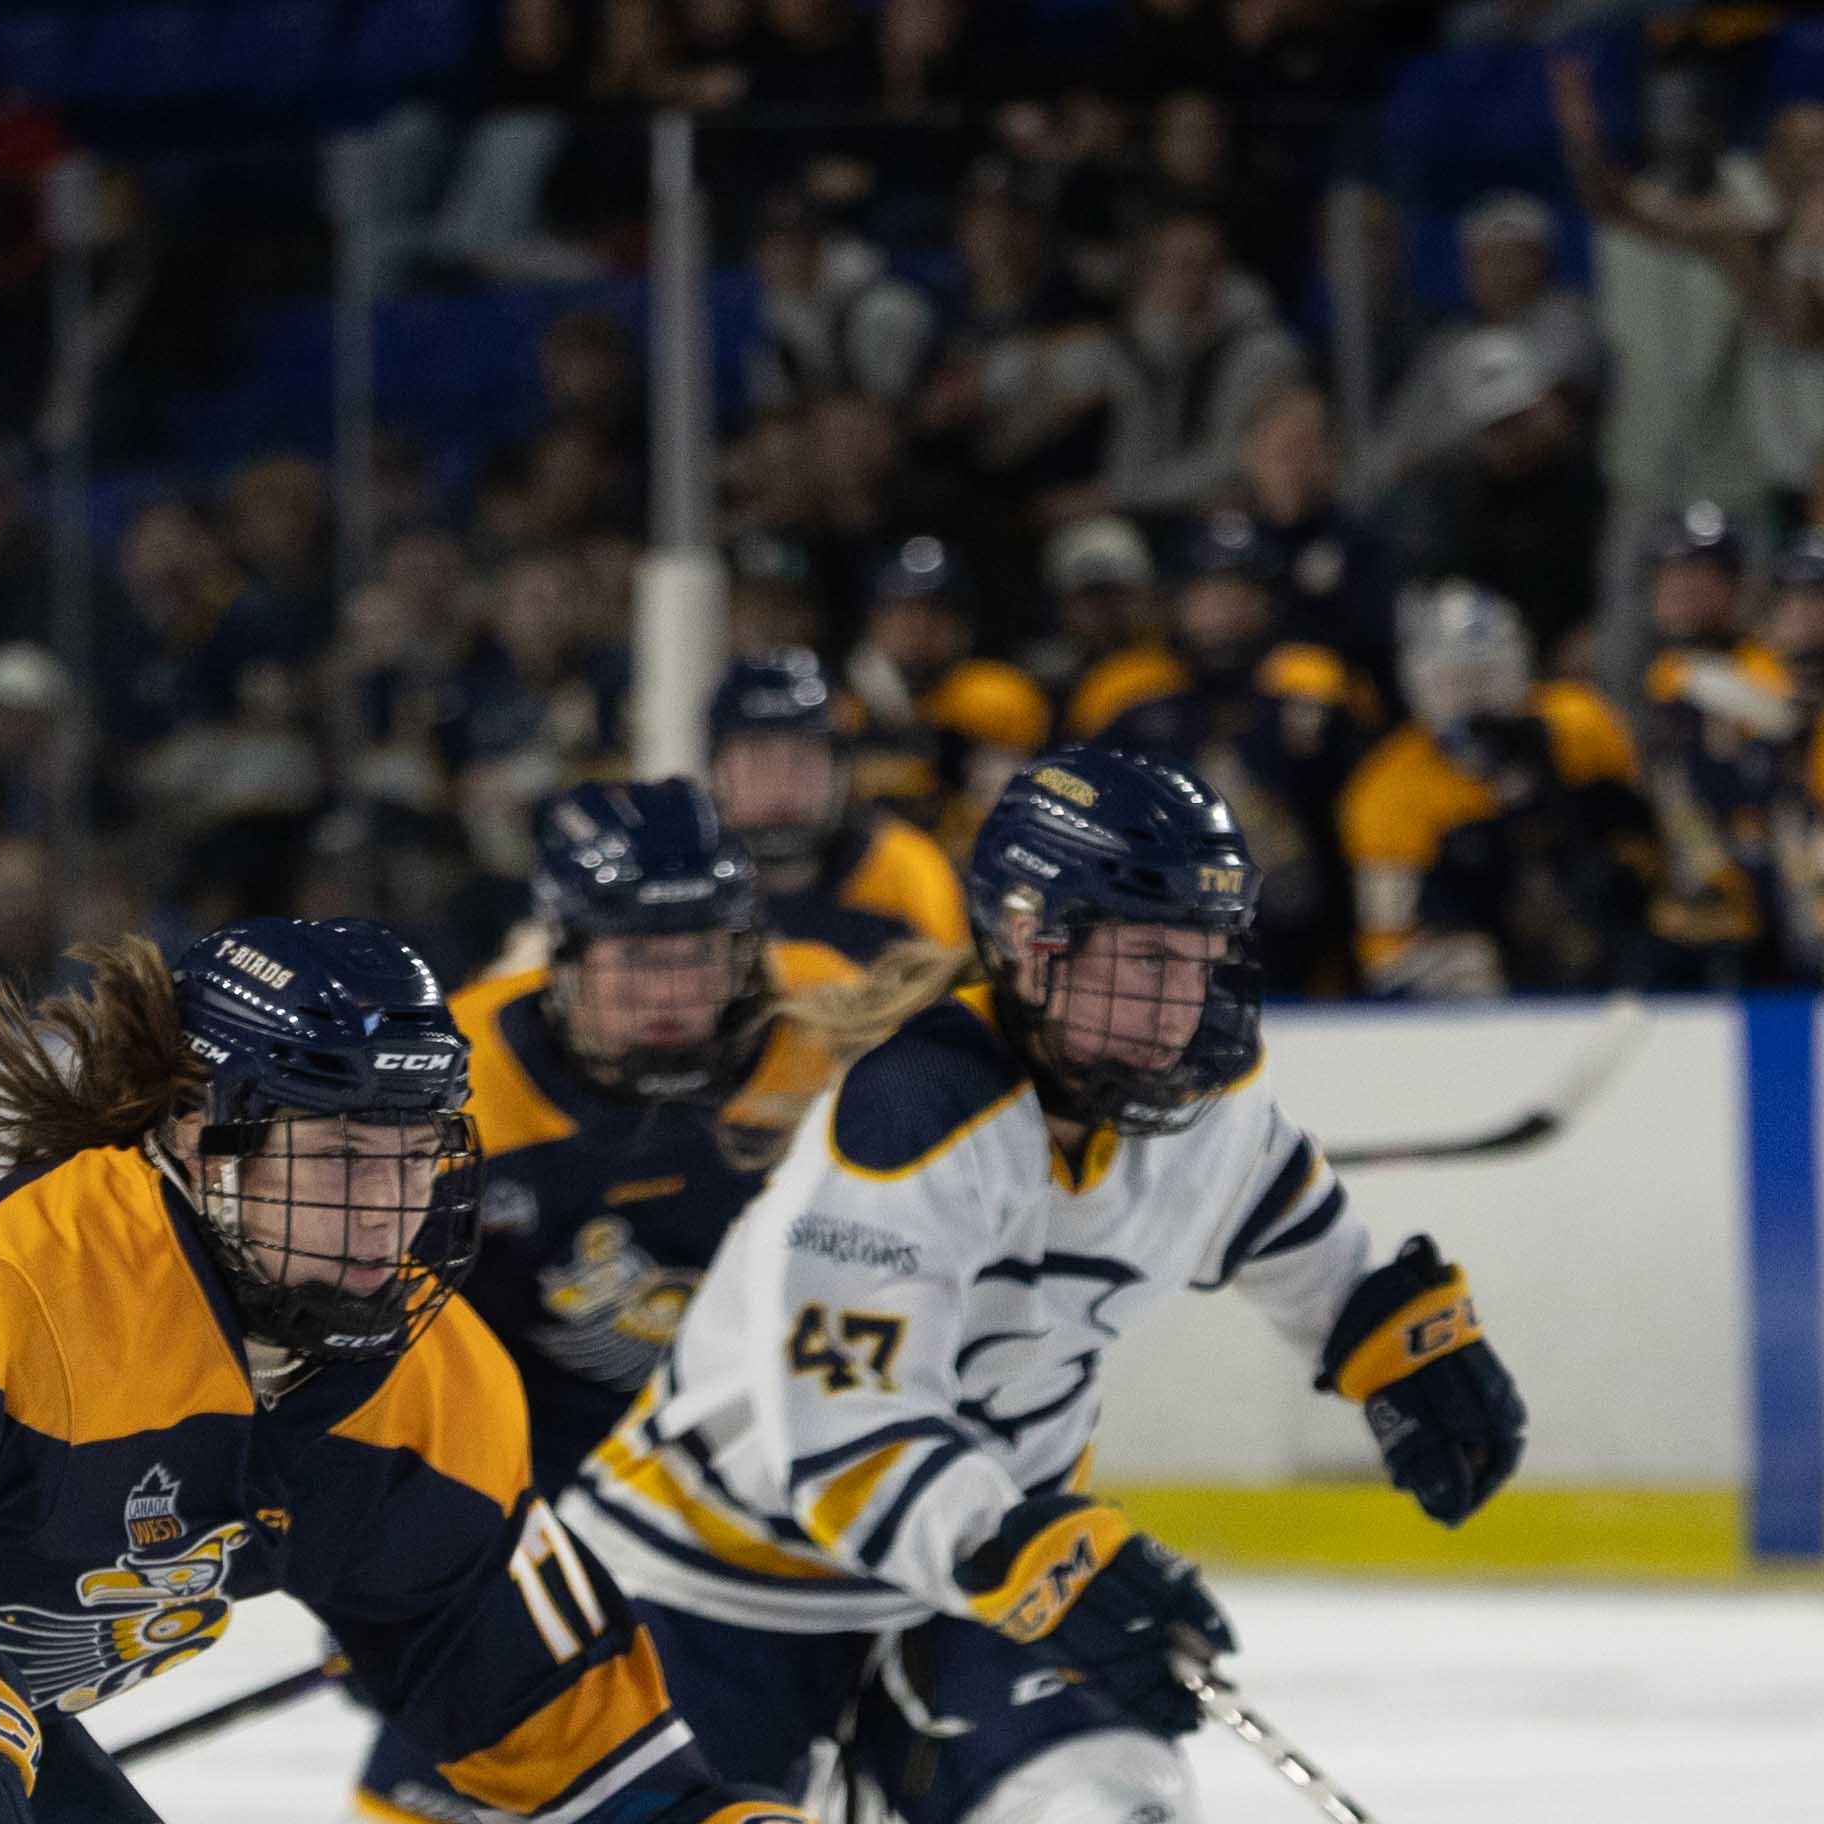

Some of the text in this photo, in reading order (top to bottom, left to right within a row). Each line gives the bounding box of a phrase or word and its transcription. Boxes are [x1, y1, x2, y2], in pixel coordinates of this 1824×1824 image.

[213, 938, 298, 991] T-BIRDS
[372, 1052, 455, 1071] CCM
[785, 1301, 909, 1397] 47
[127, 1499, 173, 1519] CANADA
[130, 1516, 182, 1546] WEST
[505, 1495, 608, 1665] 17
